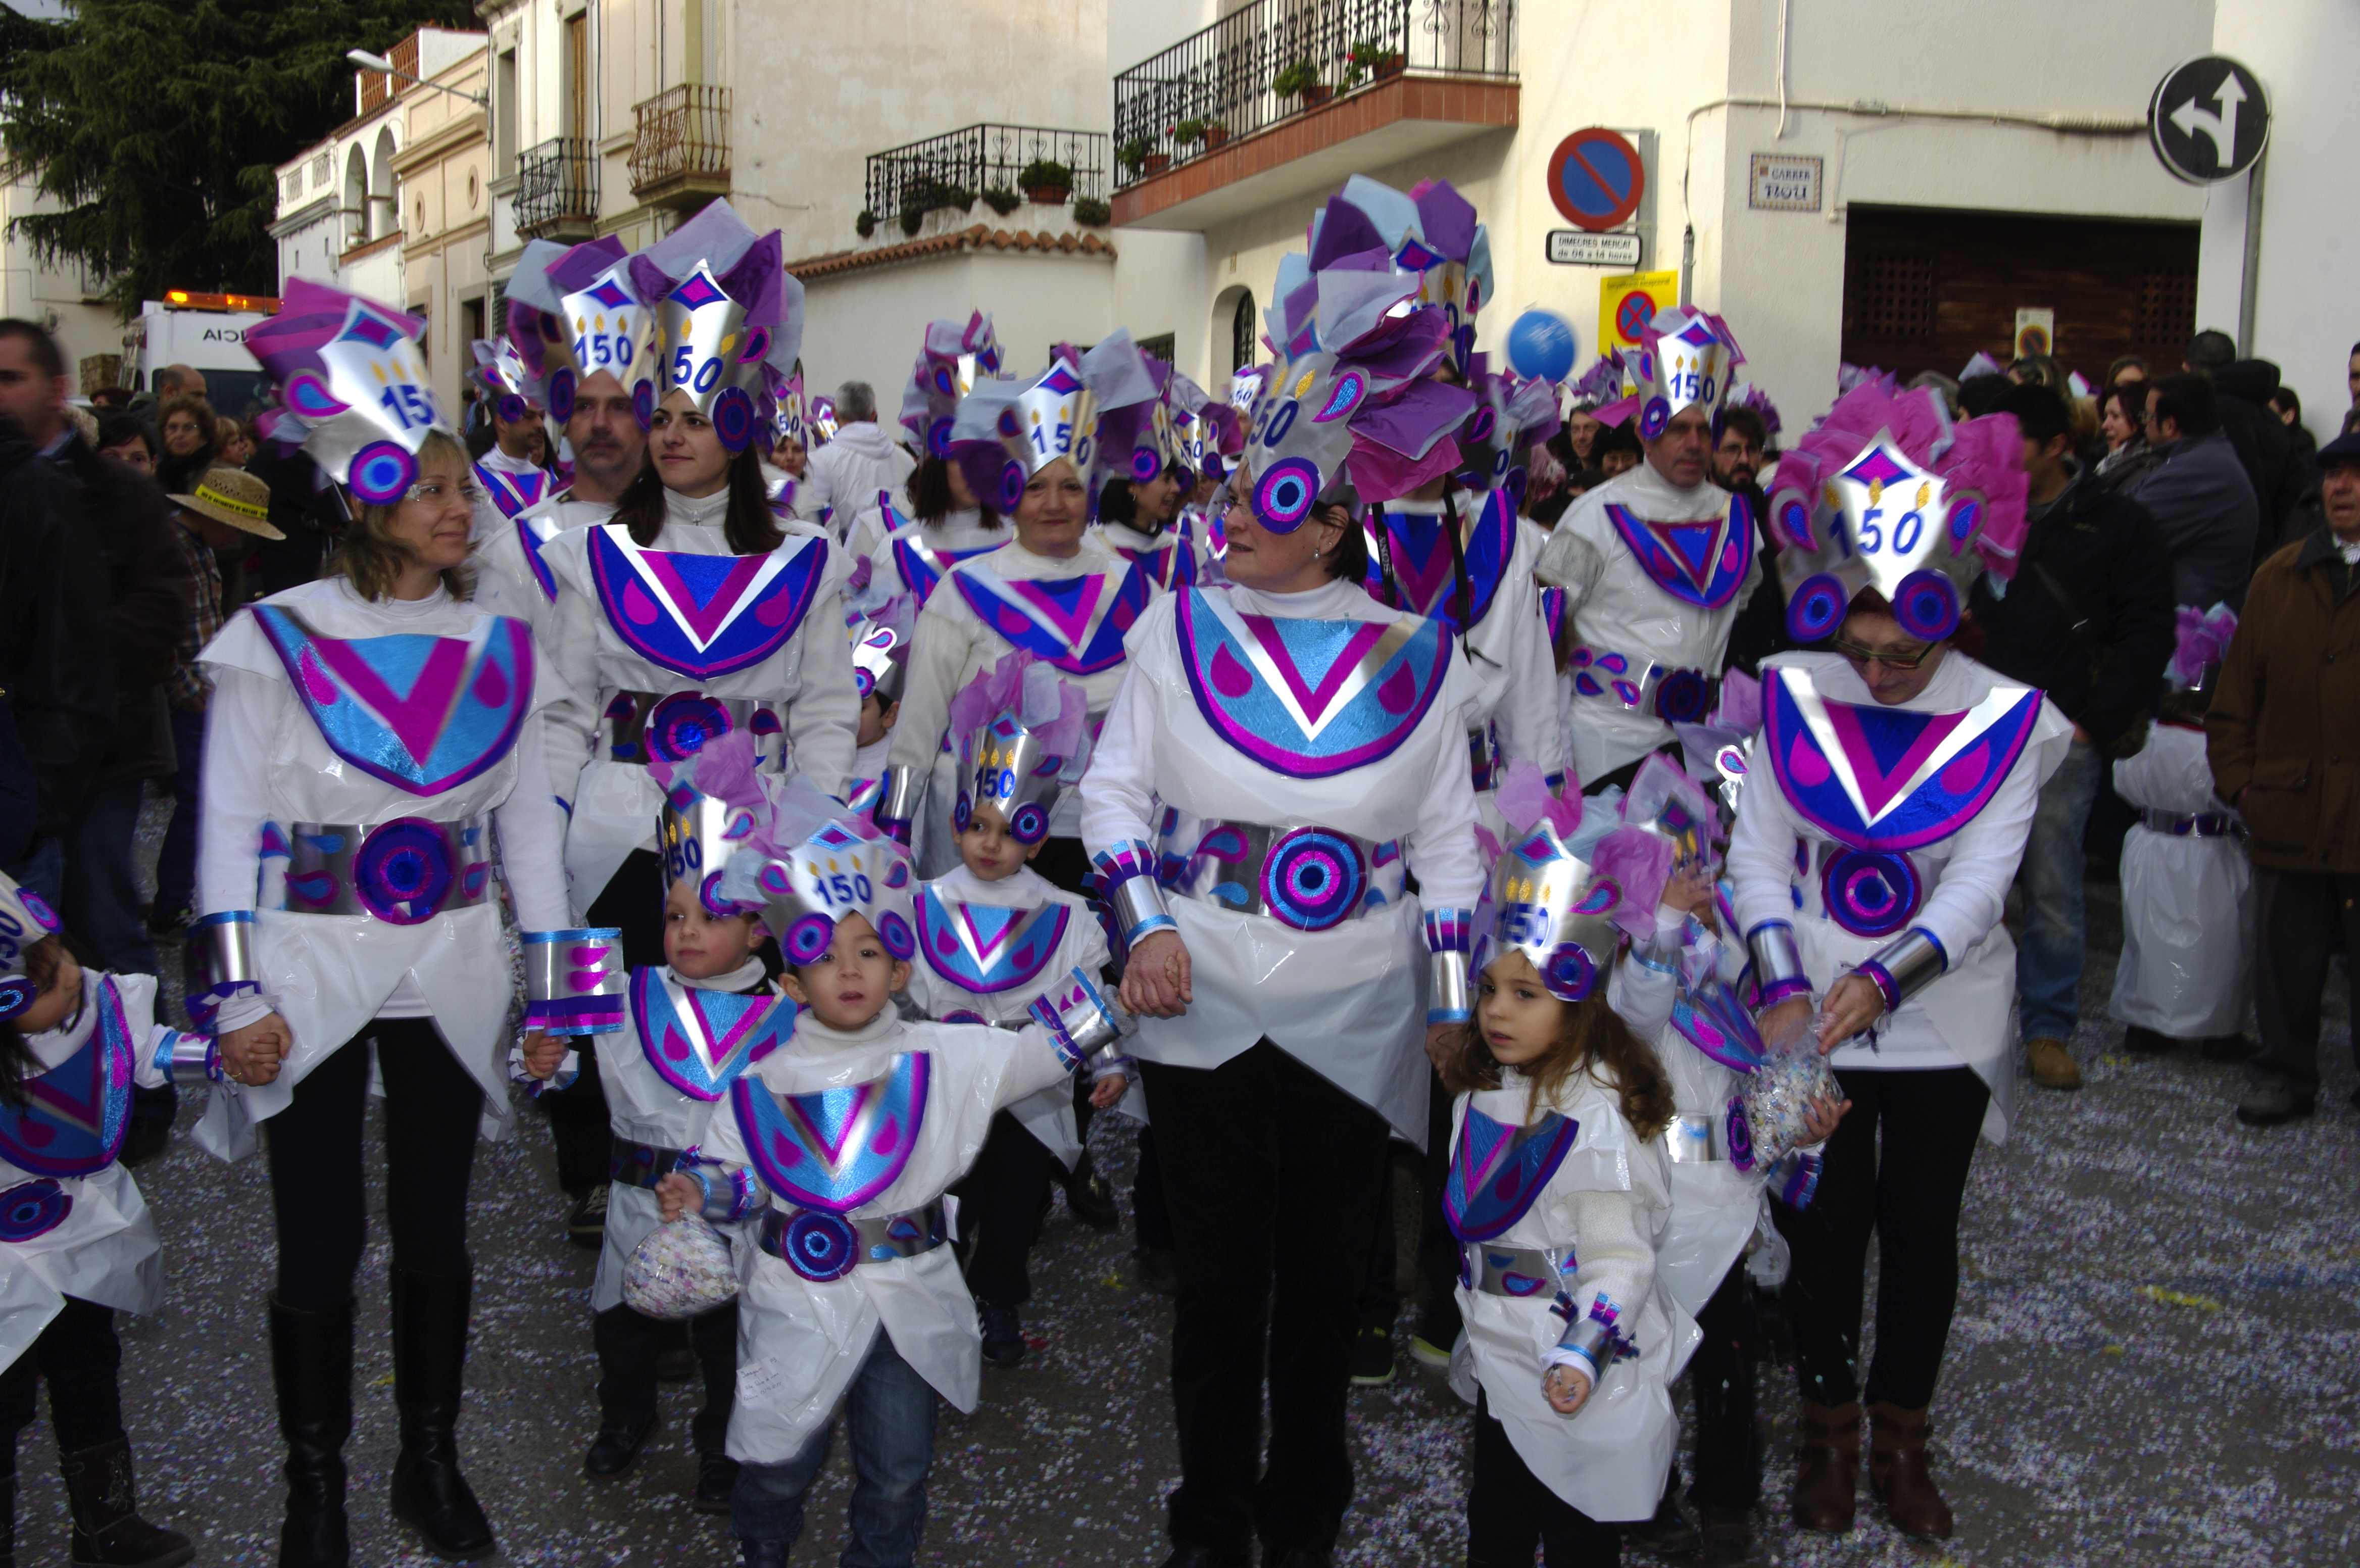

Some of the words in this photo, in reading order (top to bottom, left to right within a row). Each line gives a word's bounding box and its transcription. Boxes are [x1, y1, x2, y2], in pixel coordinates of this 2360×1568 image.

[1772, 168, 1810, 181] CARRER
[1558, 248, 1568, 259] de
[1596, 249, 1605, 260] 14
[1608, 251, 1632, 261] hores
[1559, 235, 1597, 248] DIMECRES
[1601, 238, 1631, 250] MERCAT
[574, 335, 632, 369] 150
[658, 346, 723, 394] 150
[1670, 373, 1715, 404] 150
[1030, 423, 1090, 466] 150
[1829, 509, 1922, 559] 150
[1379, 535, 1391, 575] SONY
[975, 767, 1016, 798] 150
[814, 873, 871, 905] 150
